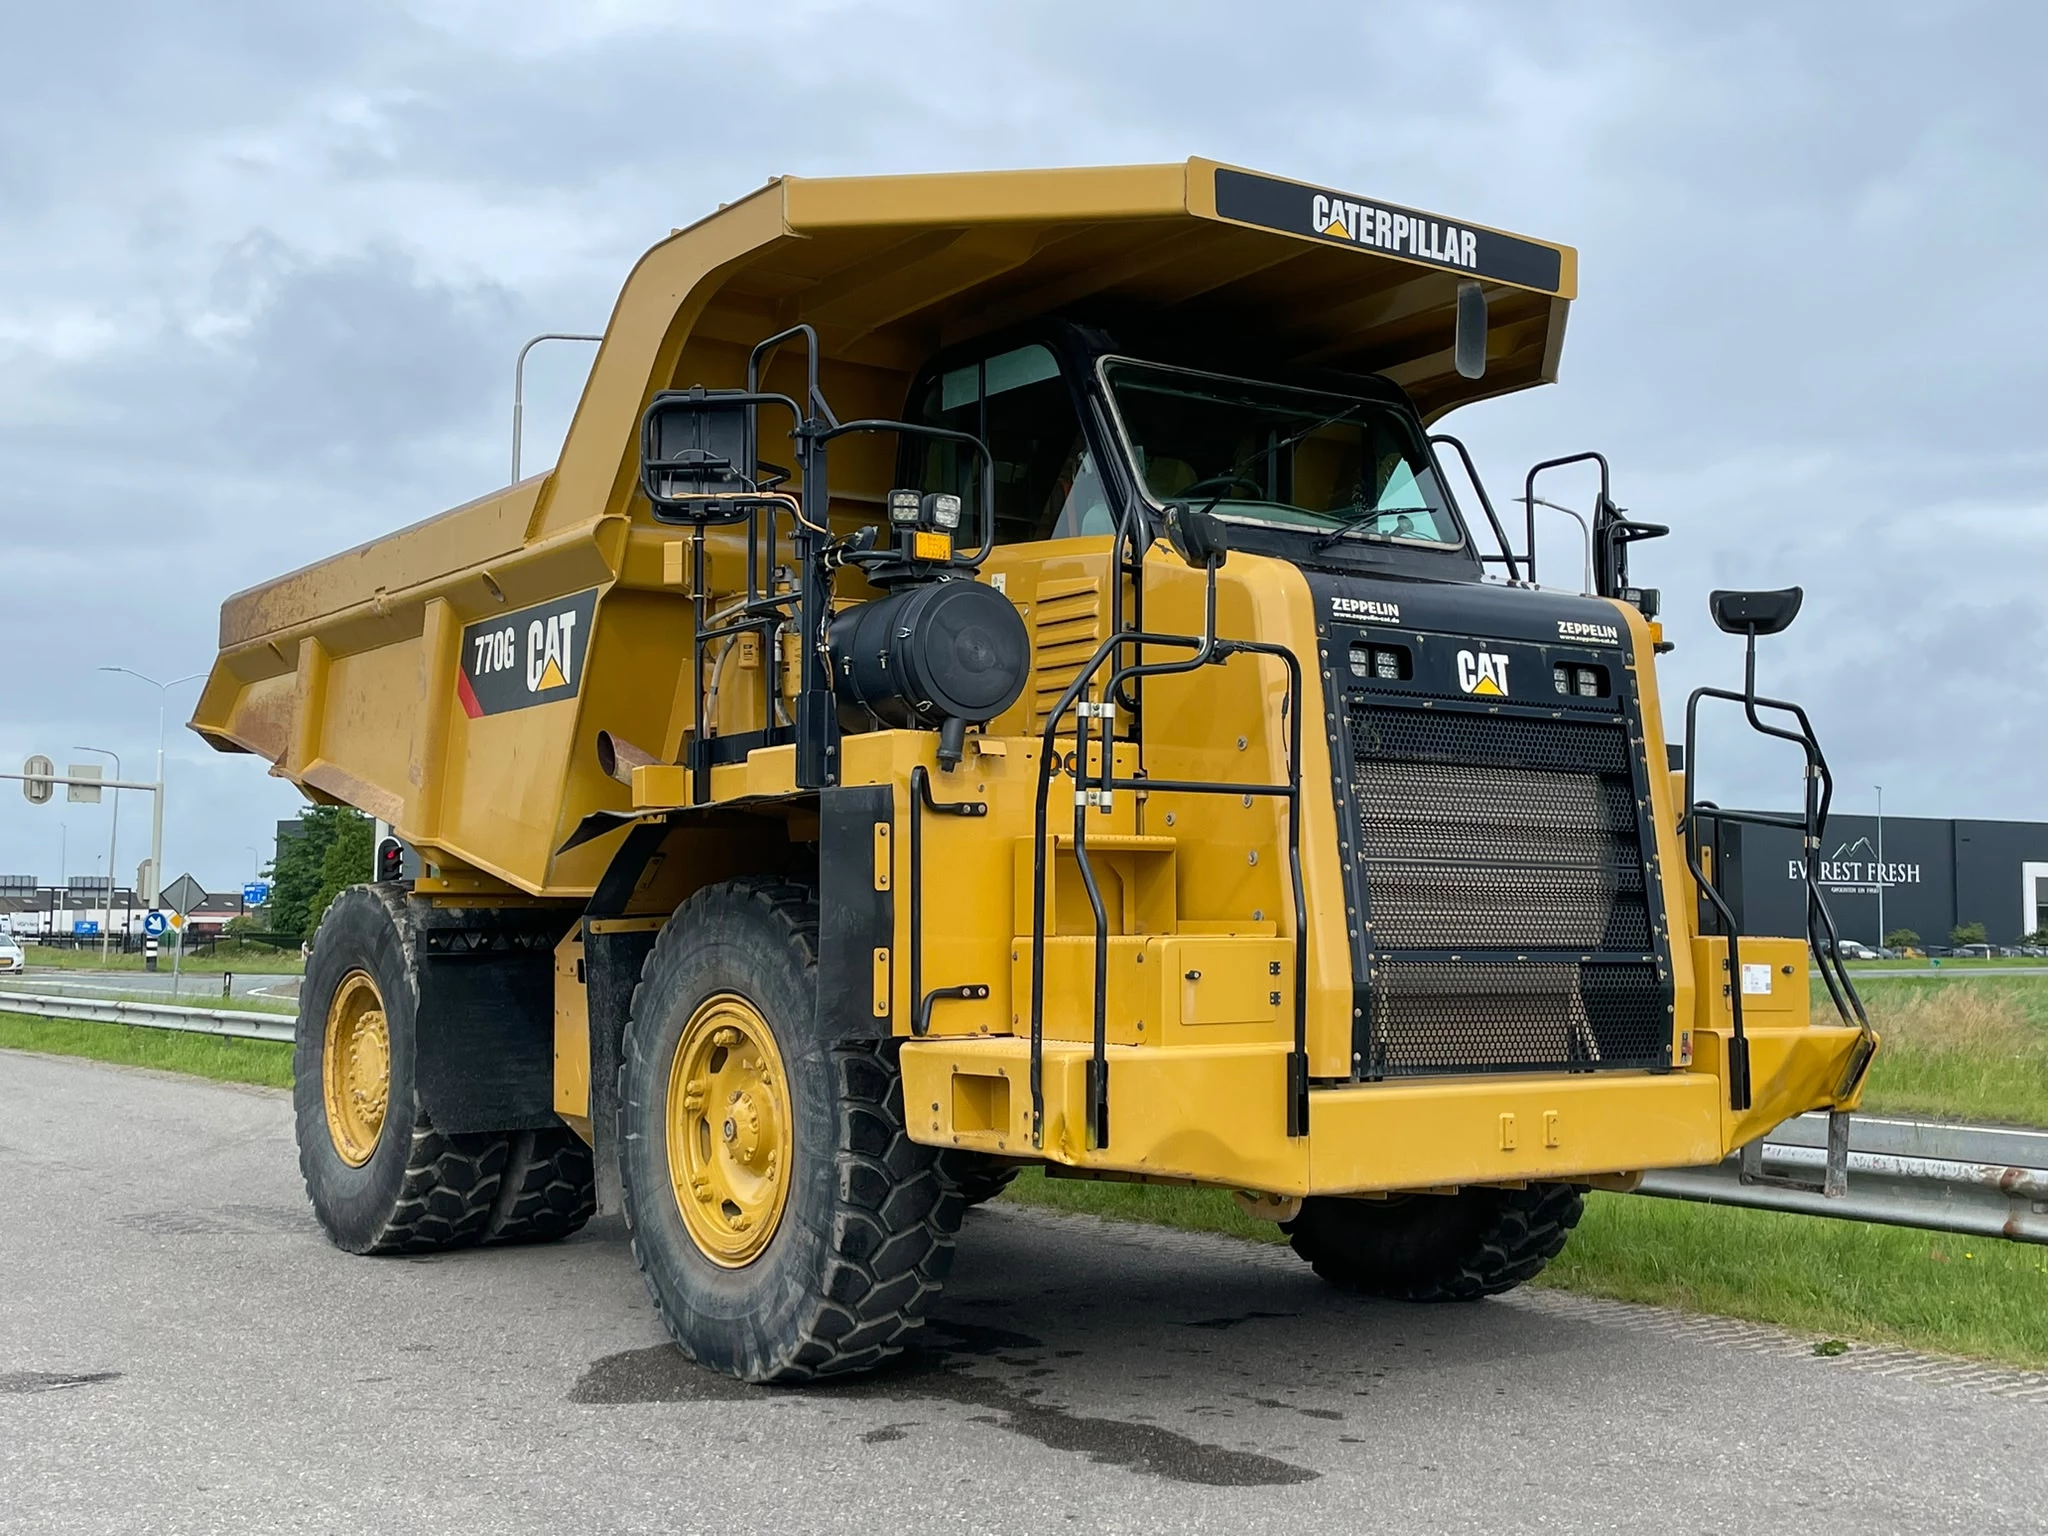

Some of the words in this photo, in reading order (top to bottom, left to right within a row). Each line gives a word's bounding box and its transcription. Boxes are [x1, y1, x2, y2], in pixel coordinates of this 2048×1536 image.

[1312, 194, 1478, 269] CATERPILLAR
[1331, 597, 1400, 617] ZEPPELIN
[1557, 620, 1618, 639] ZEPPELIN
[474, 626, 515, 676] 770G
[526, 610, 577, 693] CAT
[1456, 649, 1510, 697] CAT
[1788, 860, 1862, 881] EVREST
[1867, 862, 1921, 883] FRESH
